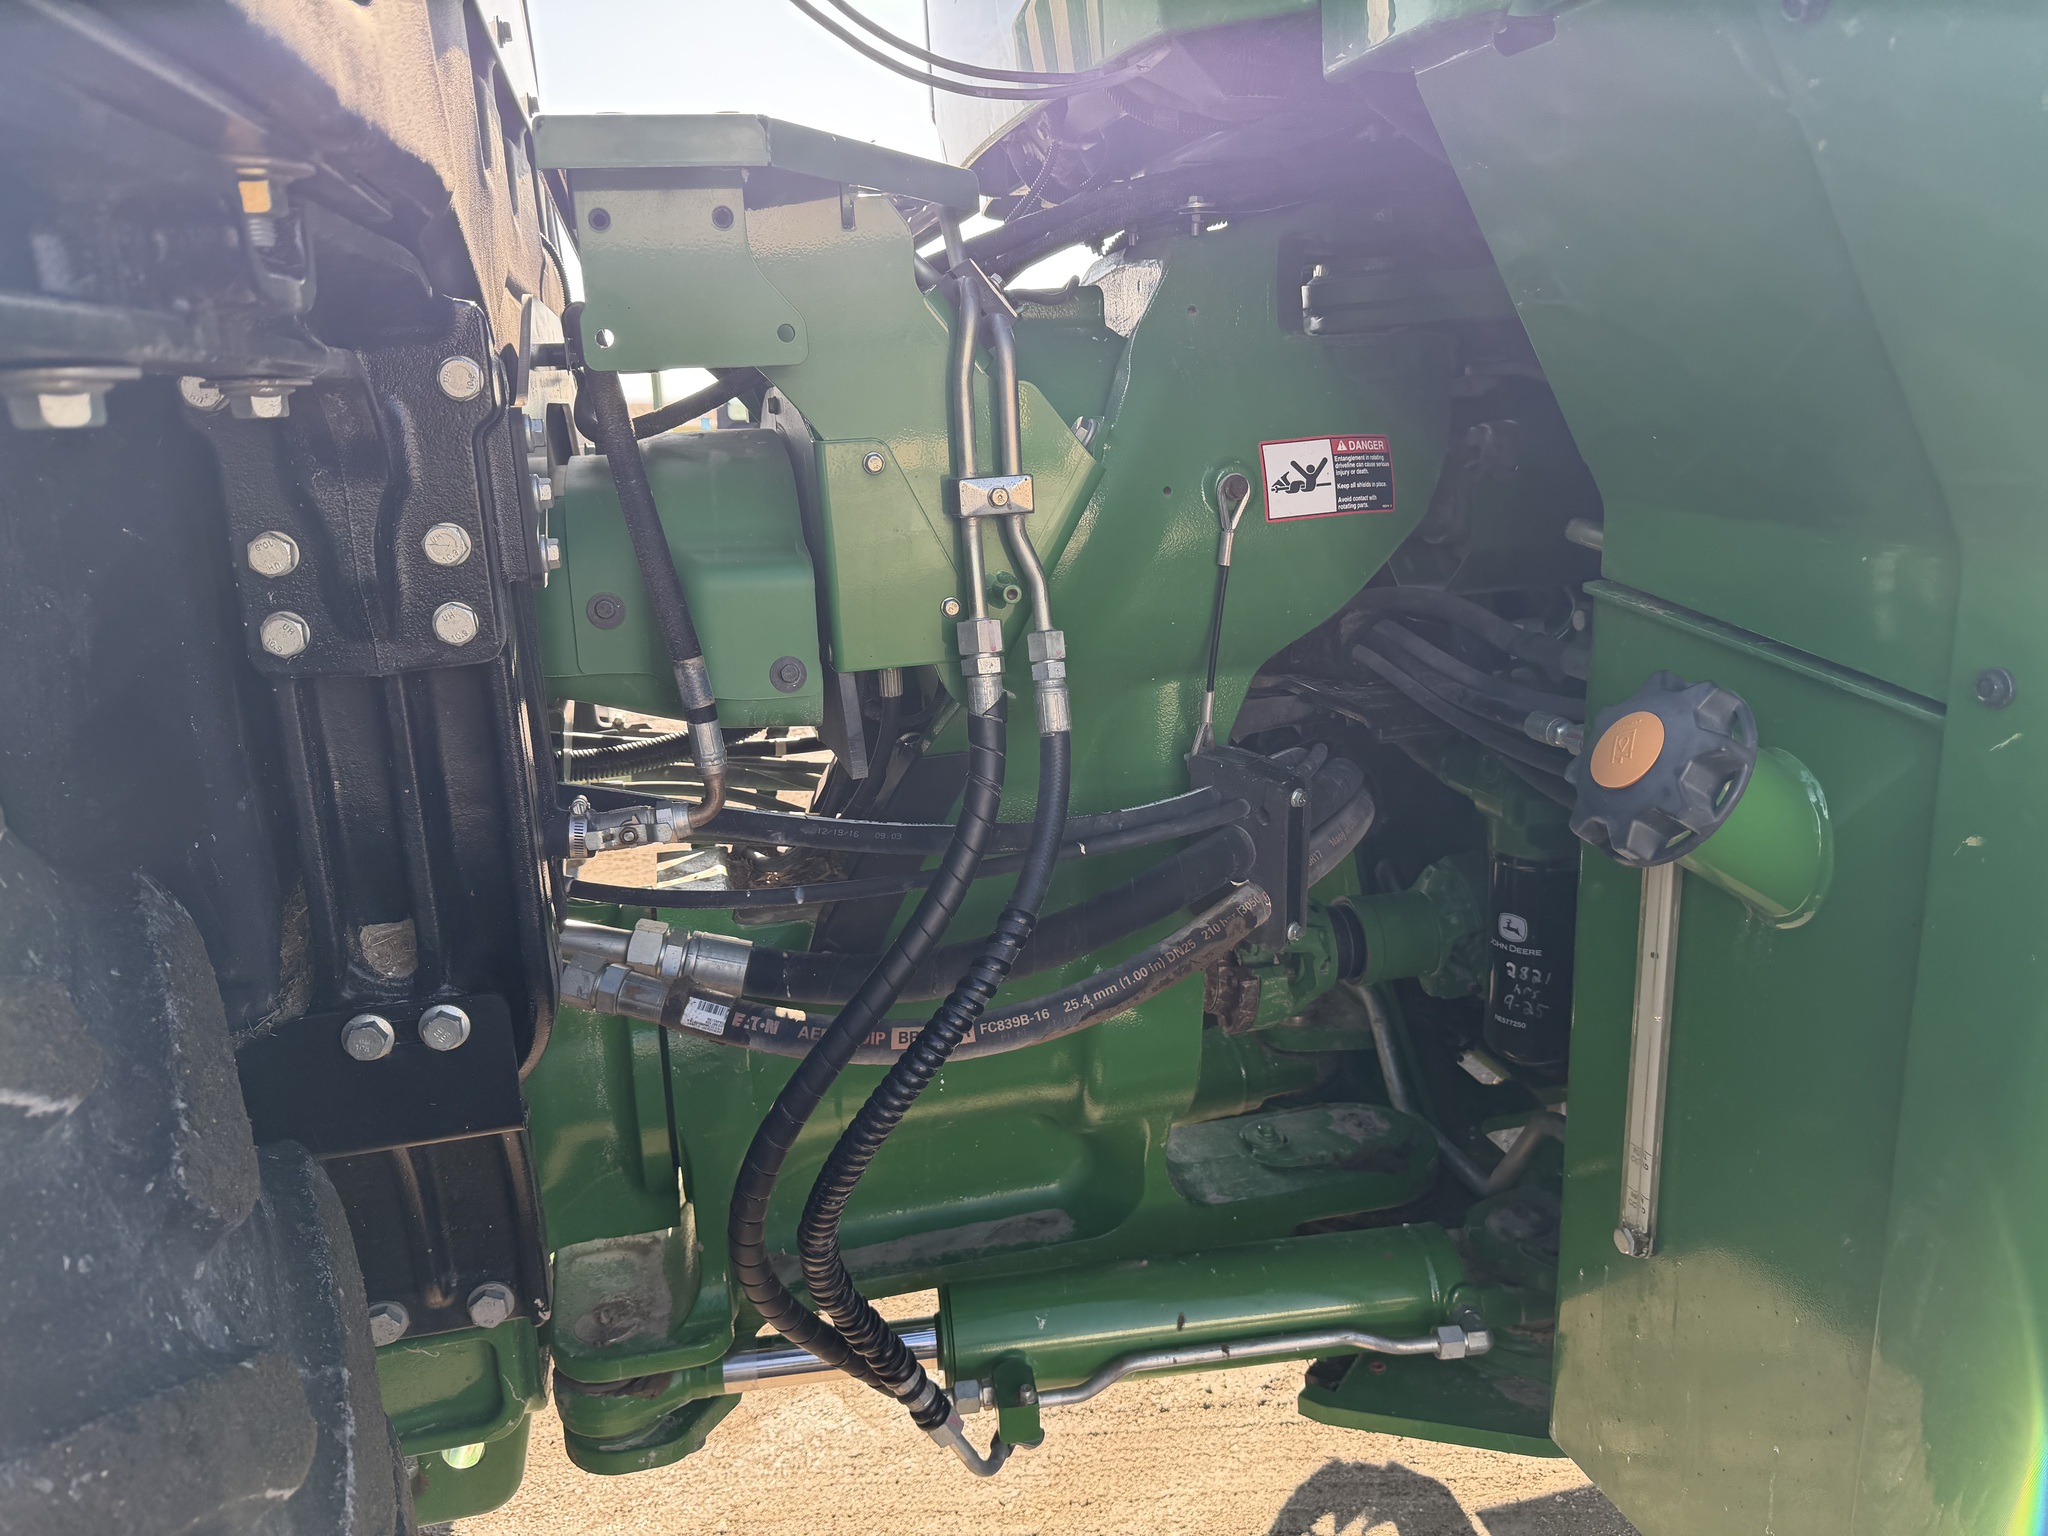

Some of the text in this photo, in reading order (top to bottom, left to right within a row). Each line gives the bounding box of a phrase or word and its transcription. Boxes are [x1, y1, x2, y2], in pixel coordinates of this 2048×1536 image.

[1348, 440, 1384, 450] DANGER
[1335, 461, 1356, 469] driveline
[1370, 454, 1385, 462] rotating
[1338, 495, 1352, 503] Avoid
[451, 629, 469, 642] 10.9
[817, 827, 860, 838] 12/19/16
[1489, 937, 1543, 957] JOHN DEERE
[979, 1008, 1050, 1036] FC839B-16
[1063, 994, 1091, 1013] 25.4
[1092, 983, 1118, 1002] mm
[1118, 967, 1149, 992] (1.00
[1149, 957, 1167, 977] in)
[1165, 940, 1197, 965] DN25
[1200, 923, 1221, 941] 210
[1506, 961, 1552, 985] 2821
[1512, 983, 1541, 999] hrs
[1504, 994, 1550, 1019] 9-25
[1494, 1013, 1527, 1029] RE577250
